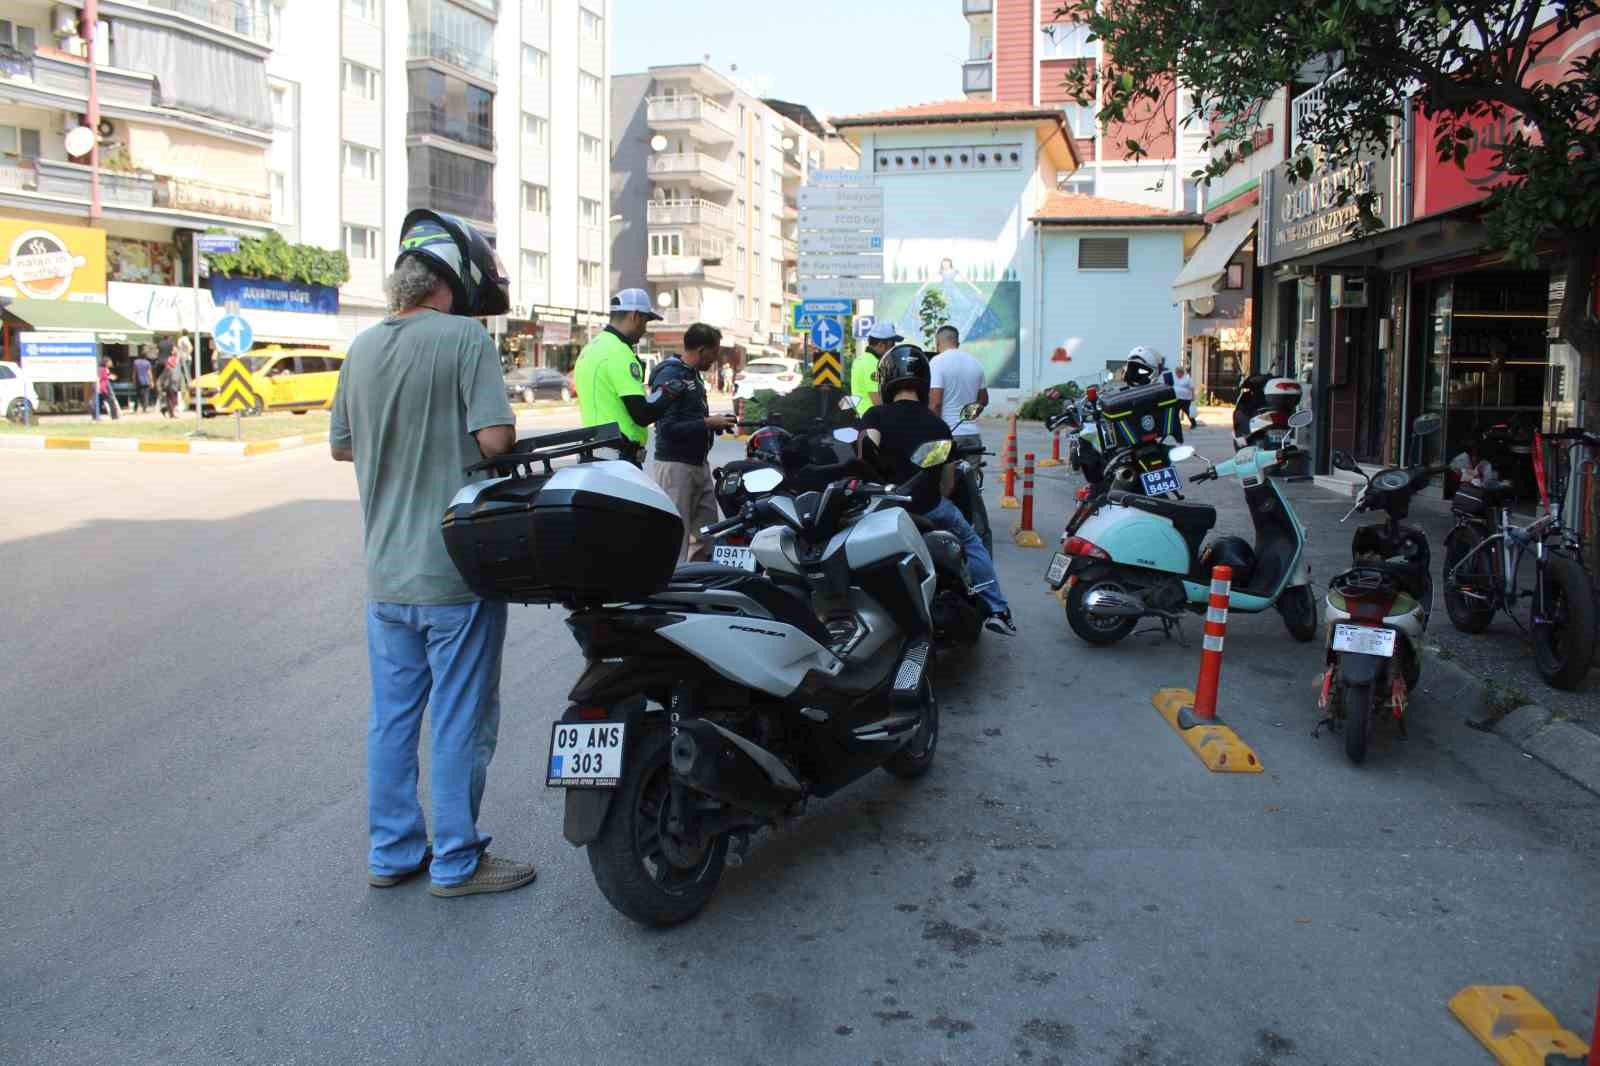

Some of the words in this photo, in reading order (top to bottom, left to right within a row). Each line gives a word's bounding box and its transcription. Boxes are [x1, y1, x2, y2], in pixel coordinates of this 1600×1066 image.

[728, 624, 786, 638] FORZA
[558, 728, 578, 748] 09
[587, 727, 619, 748] ANS
[571, 753, 602, 774] 303
